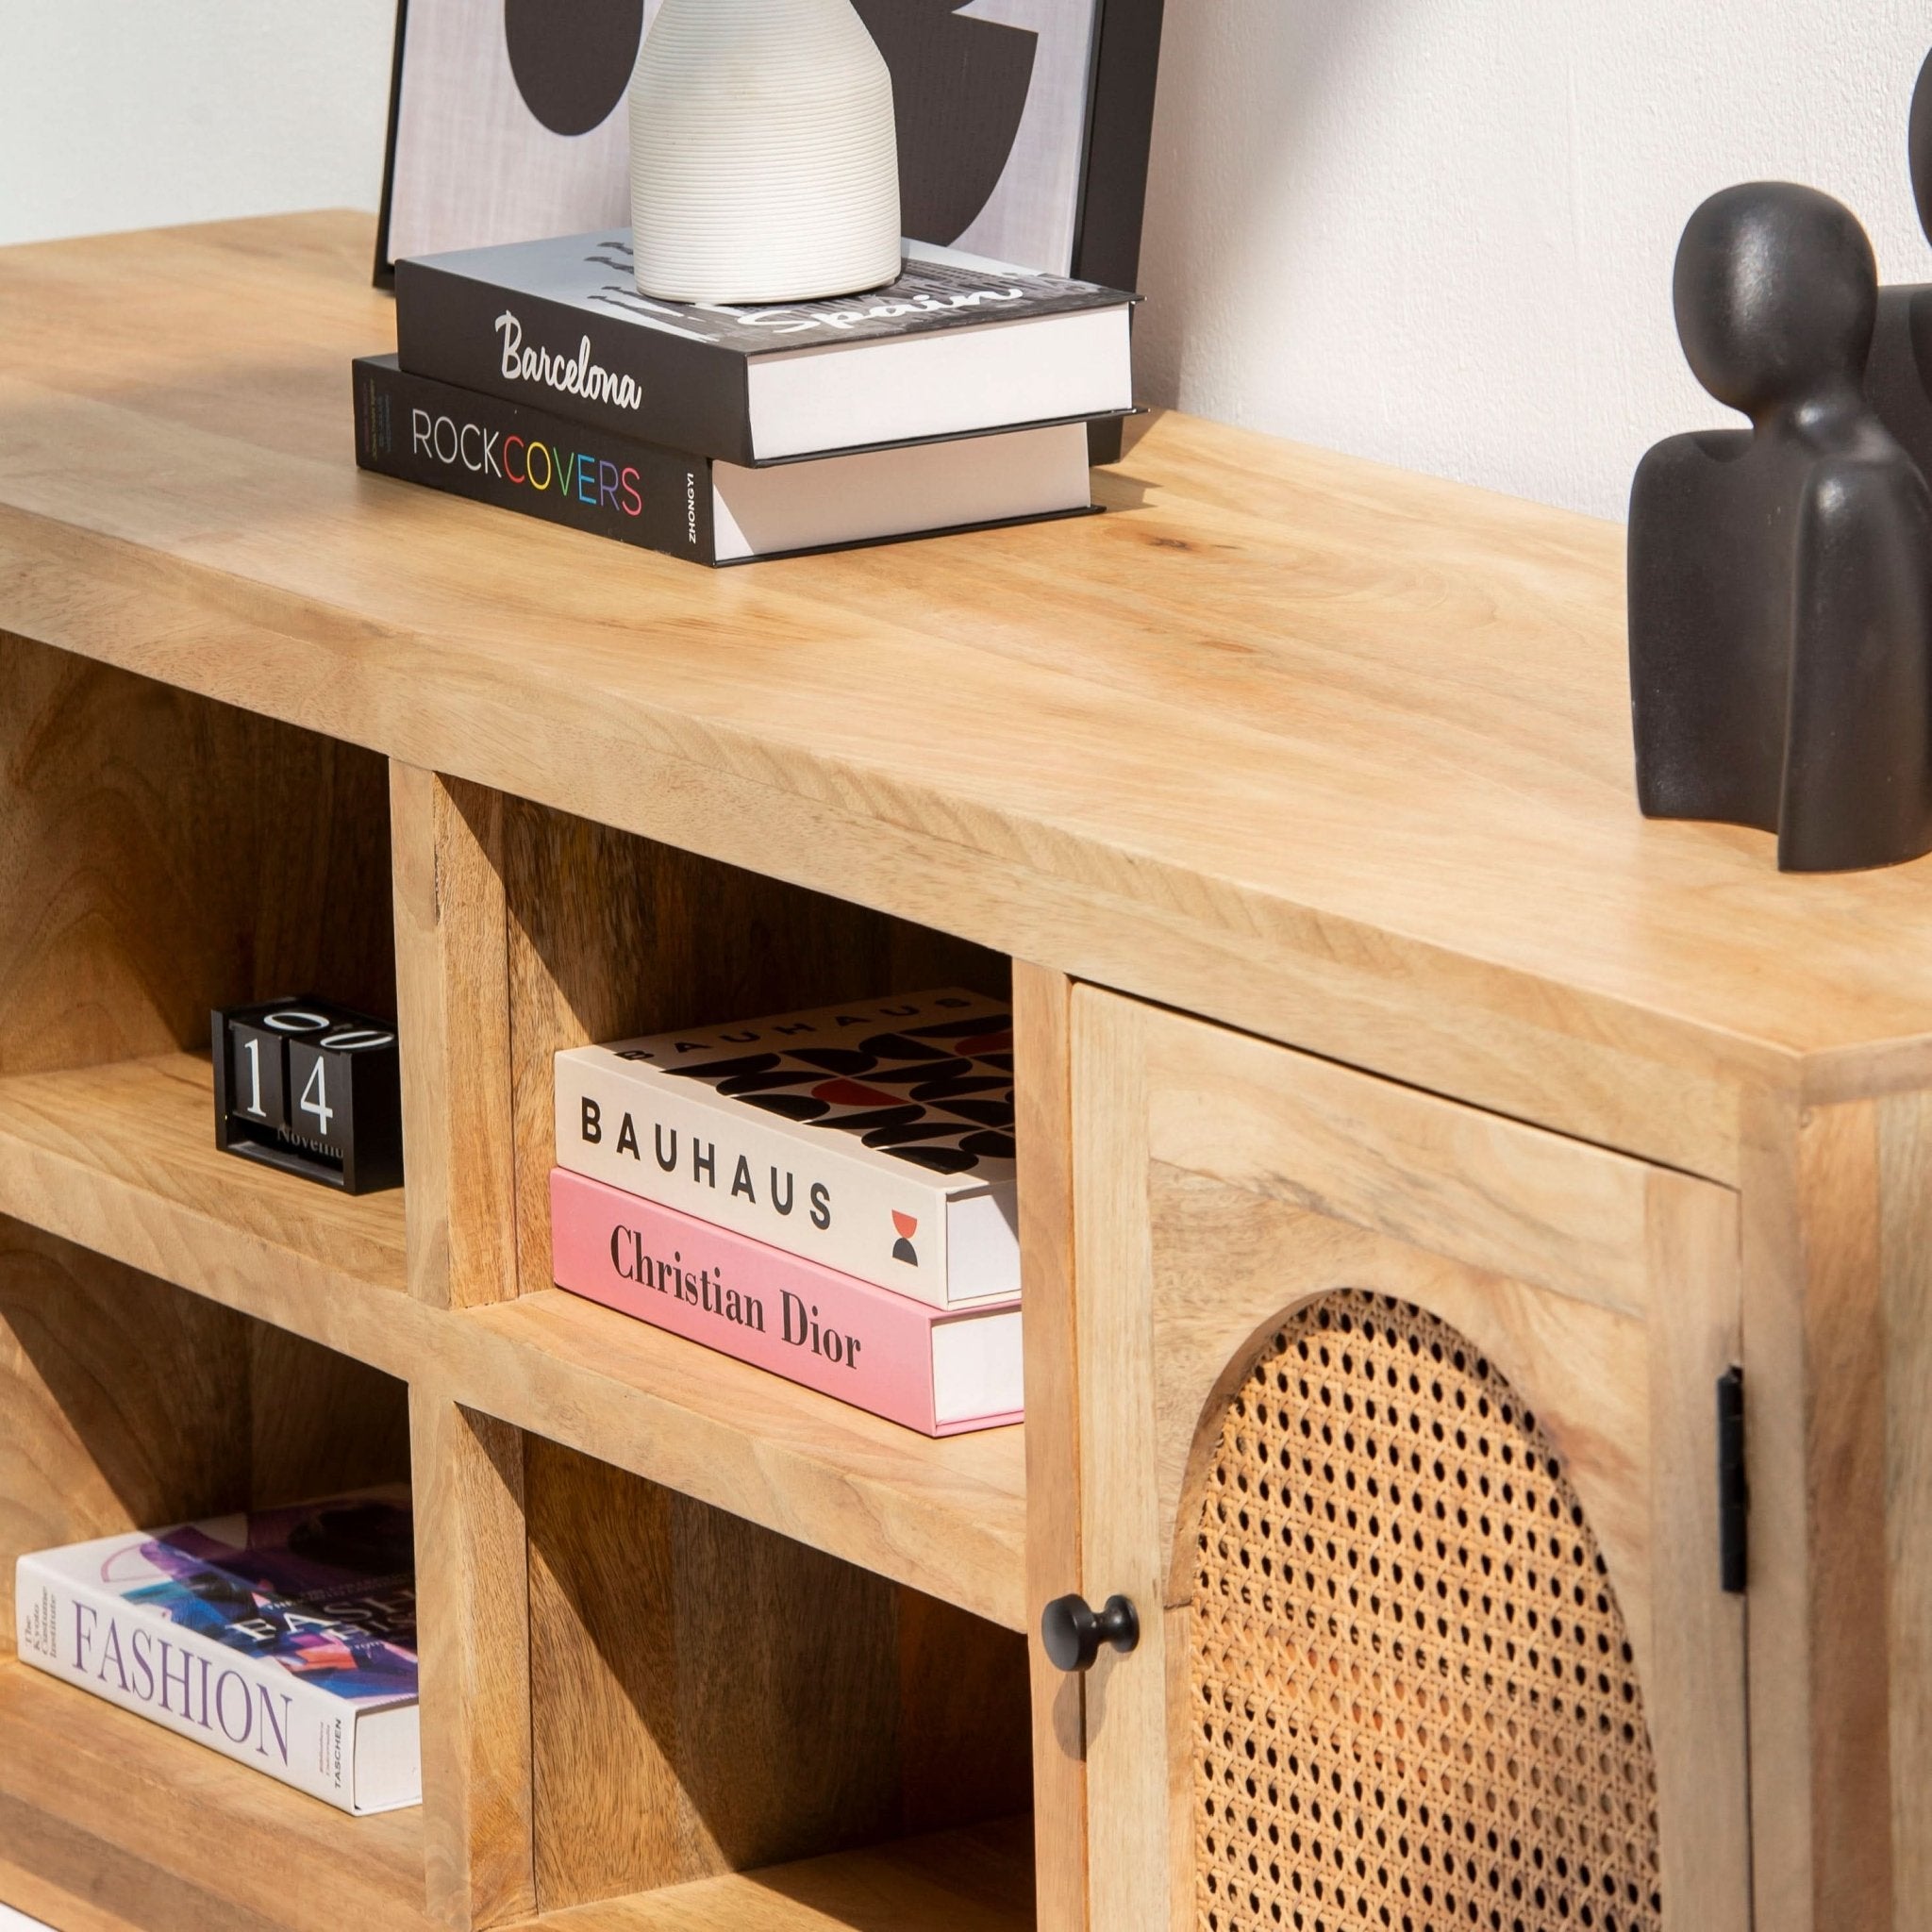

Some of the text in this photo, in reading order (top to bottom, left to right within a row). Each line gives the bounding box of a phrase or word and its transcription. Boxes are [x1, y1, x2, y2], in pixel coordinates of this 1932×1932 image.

[494, 308, 642, 411] Barcelona
[739, 287, 1024, 334] Spain
[687, 473, 696, 544] ZHONGYI
[613, 996, 972, 1061] BAUHAUS
[581, 1096, 832, 1231] BAUHAUS
[610, 1224, 861, 1371] Christian Dior
[72, 1600, 292, 1767] FASHION
